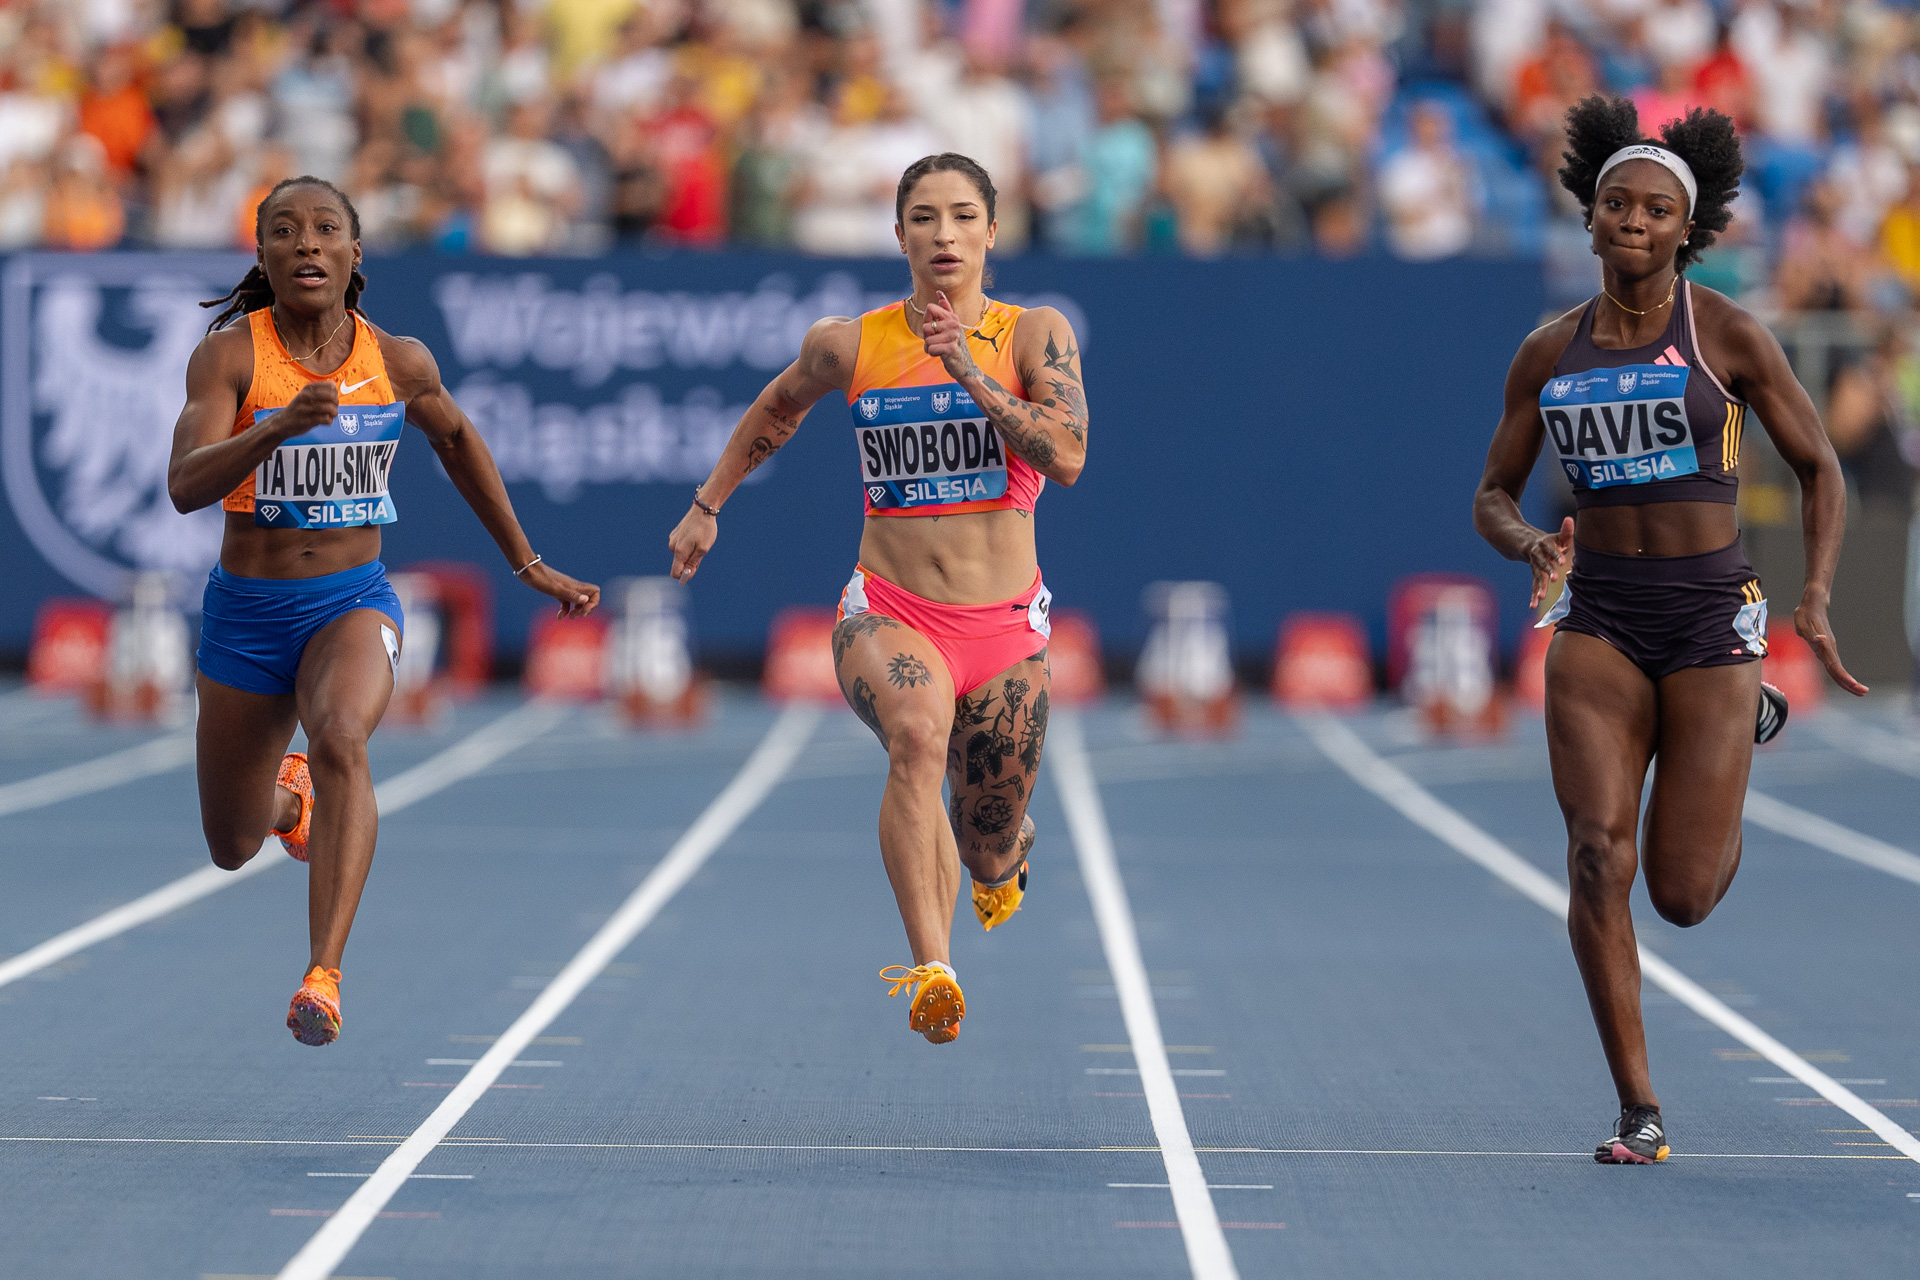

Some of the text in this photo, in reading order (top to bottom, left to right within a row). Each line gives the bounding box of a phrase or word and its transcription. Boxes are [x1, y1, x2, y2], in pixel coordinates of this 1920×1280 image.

[1627, 148, 1666, 160] adidas
[1545, 401, 1687, 457] DAVIS
[863, 420, 1003, 478] SWOBODA
[262, 443, 395, 497] TA LOU-SMITH
[1590, 454, 1677, 484] SILESIA
[905, 477, 988, 501] SILESIA
[307, 502, 388, 523] SILESIA
